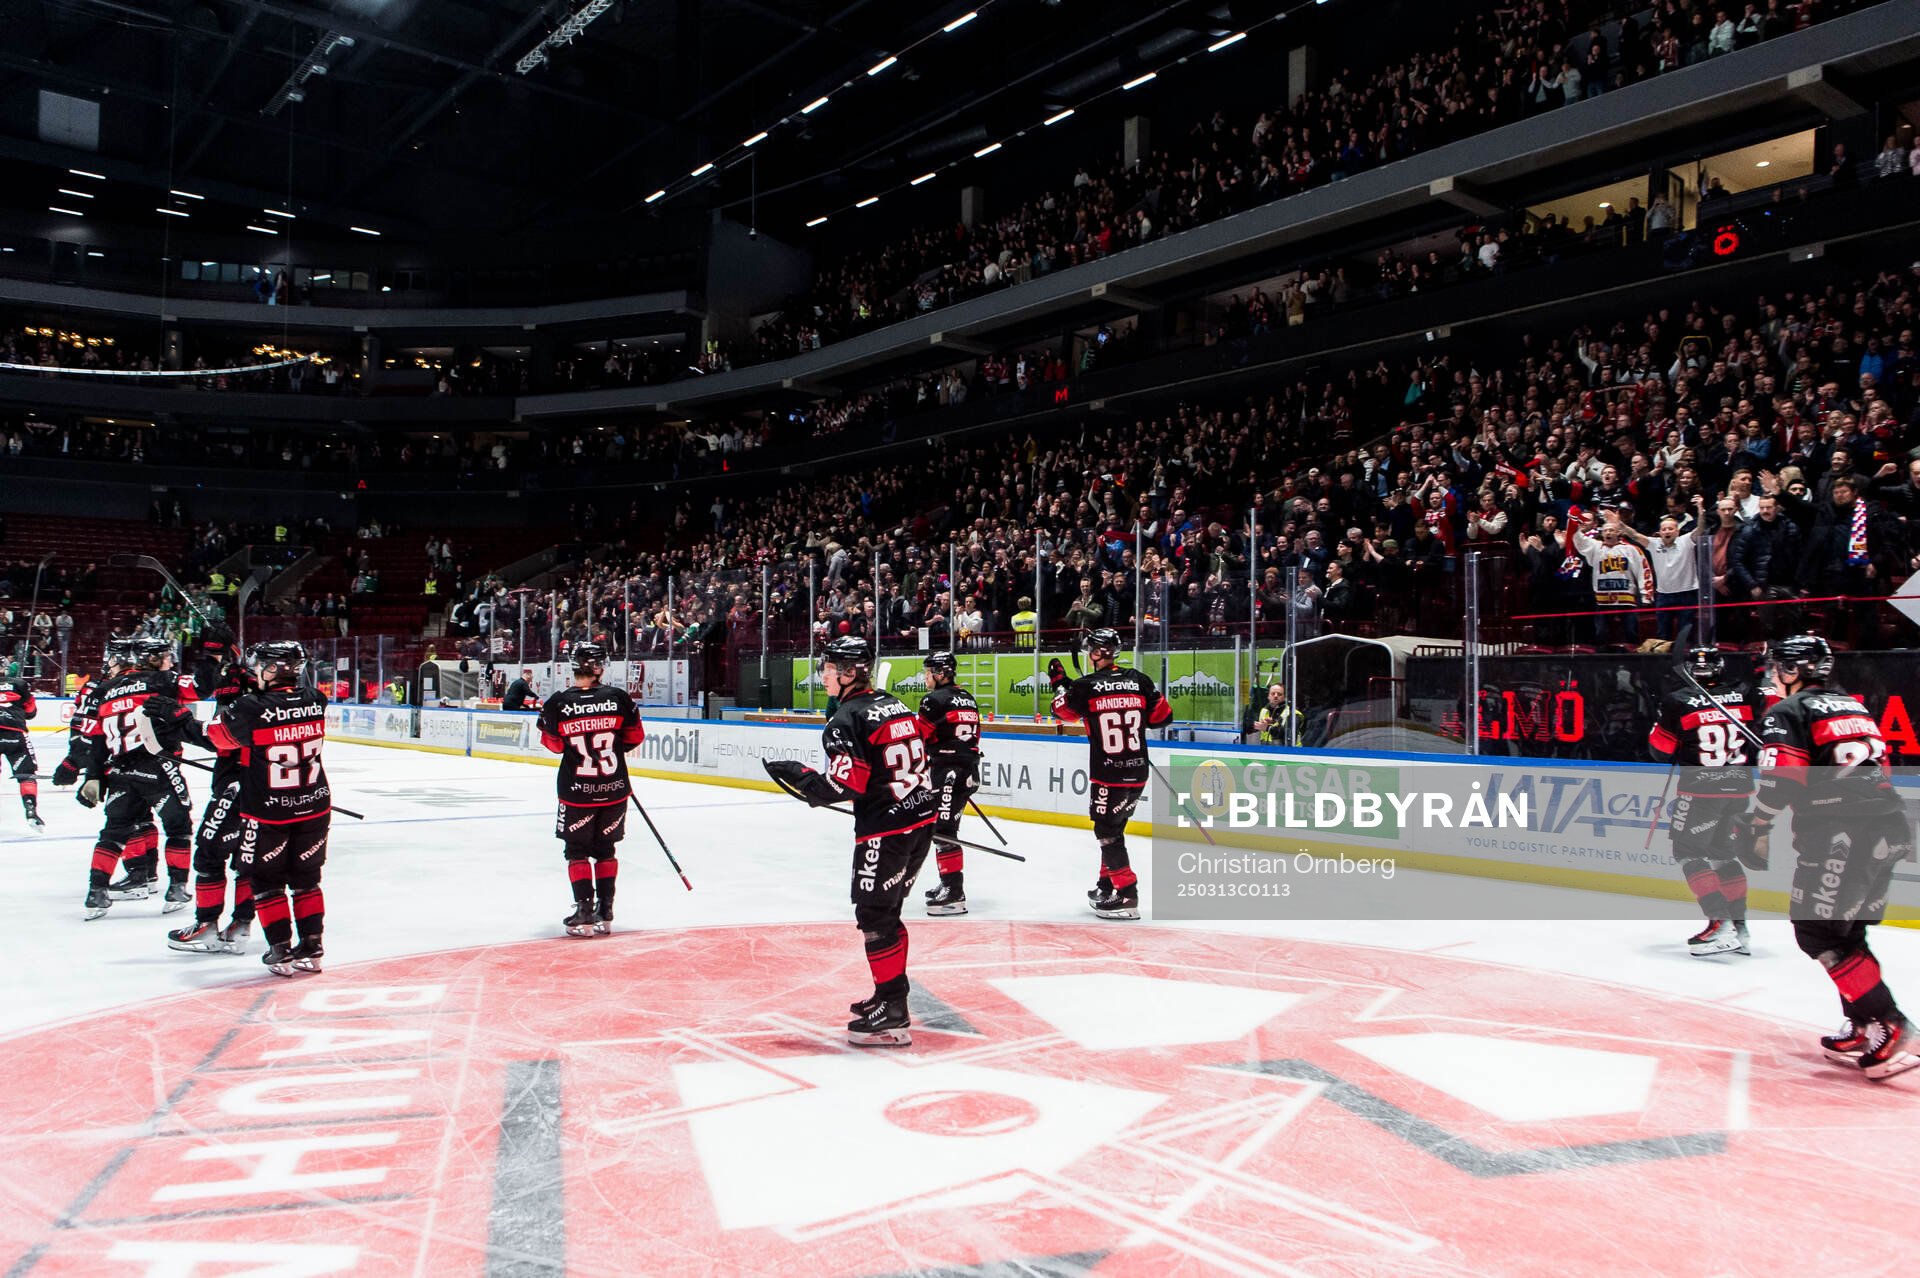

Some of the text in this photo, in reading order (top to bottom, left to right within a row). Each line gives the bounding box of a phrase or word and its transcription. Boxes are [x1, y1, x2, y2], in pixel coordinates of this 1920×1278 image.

[1713, 225, 1740, 256] Ö
[1055, 387, 1068, 404] M
[1104, 680, 1140, 692] bravida
[1167, 681, 1235, 699] ngtvättbilen
[276, 702, 323, 721] bravida
[574, 699, 618, 715] bravida
[273, 722, 323, 742] HAAPALA
[627, 728, 700, 764] mobil
[1100, 710, 1141, 754] 63
[1697, 724, 1748, 767] 95
[266, 738, 322, 789] 27
[570, 732, 618, 776] 13
[713, 744, 819, 764] HEDIN AUTOMOTIVE
[885, 738, 932, 801] 32
[938, 785, 953, 821] akea
[1094, 785, 1109, 815] ake
[203, 798, 233, 840] akea
[557, 802, 567, 832] ake
[240, 818, 259, 864] akea
[1466, 837, 1499, 849] YOUR
[1502, 840, 1558, 855] LOGISTIC
[1562, 846, 1622, 861] PARTNER
[857, 836, 882, 892] akea
[1811, 858, 1847, 919] akea
